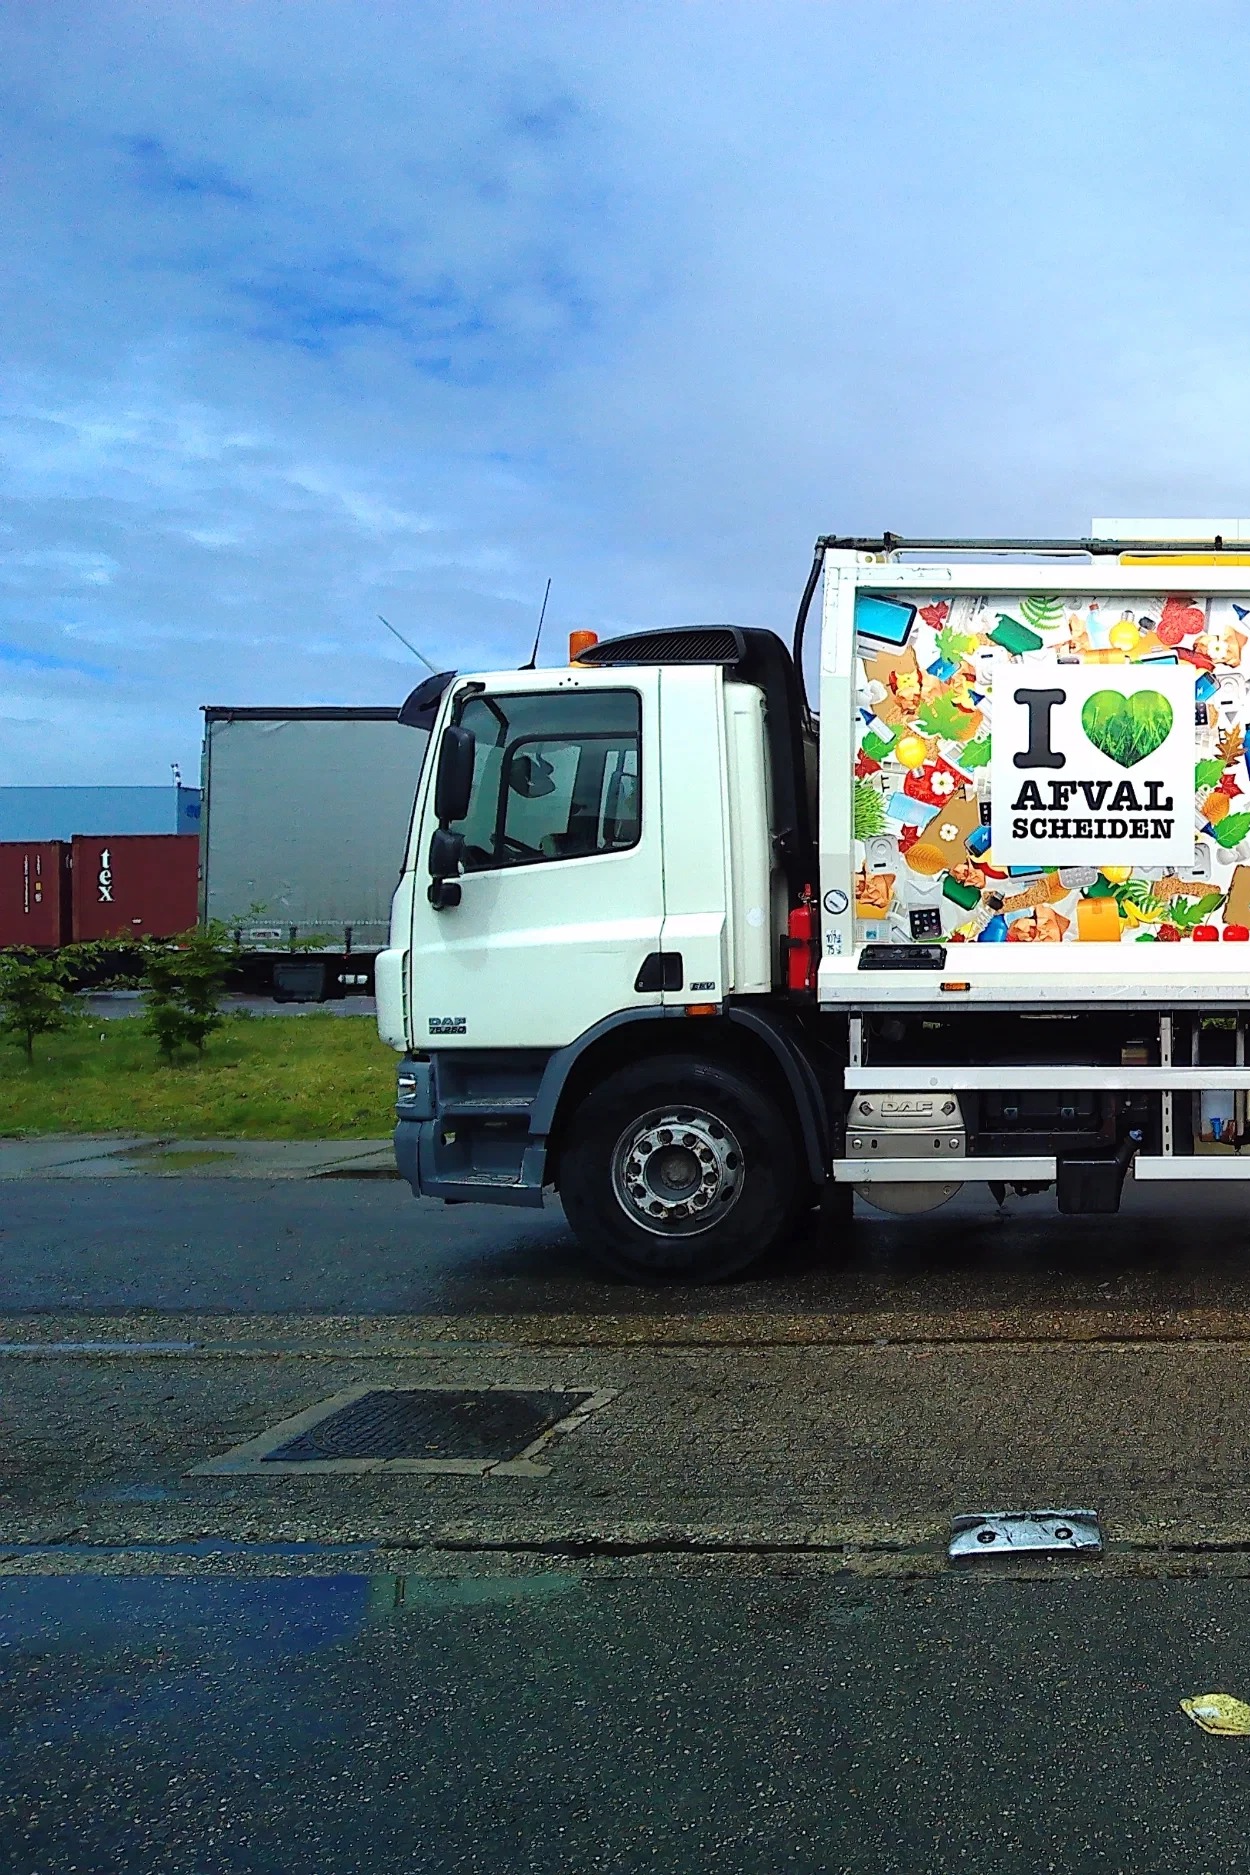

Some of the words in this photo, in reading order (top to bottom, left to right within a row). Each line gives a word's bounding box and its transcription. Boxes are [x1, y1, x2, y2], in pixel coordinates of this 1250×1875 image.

[1013, 688, 1067, 770] I
[1010, 779, 1174, 812] AFVAL
[1012, 817, 1175, 839] SCHEIDEN
[98, 848, 114, 902] tex
[428, 1016, 467, 1026] DAF
[881, 1101, 933, 1113] DAF
